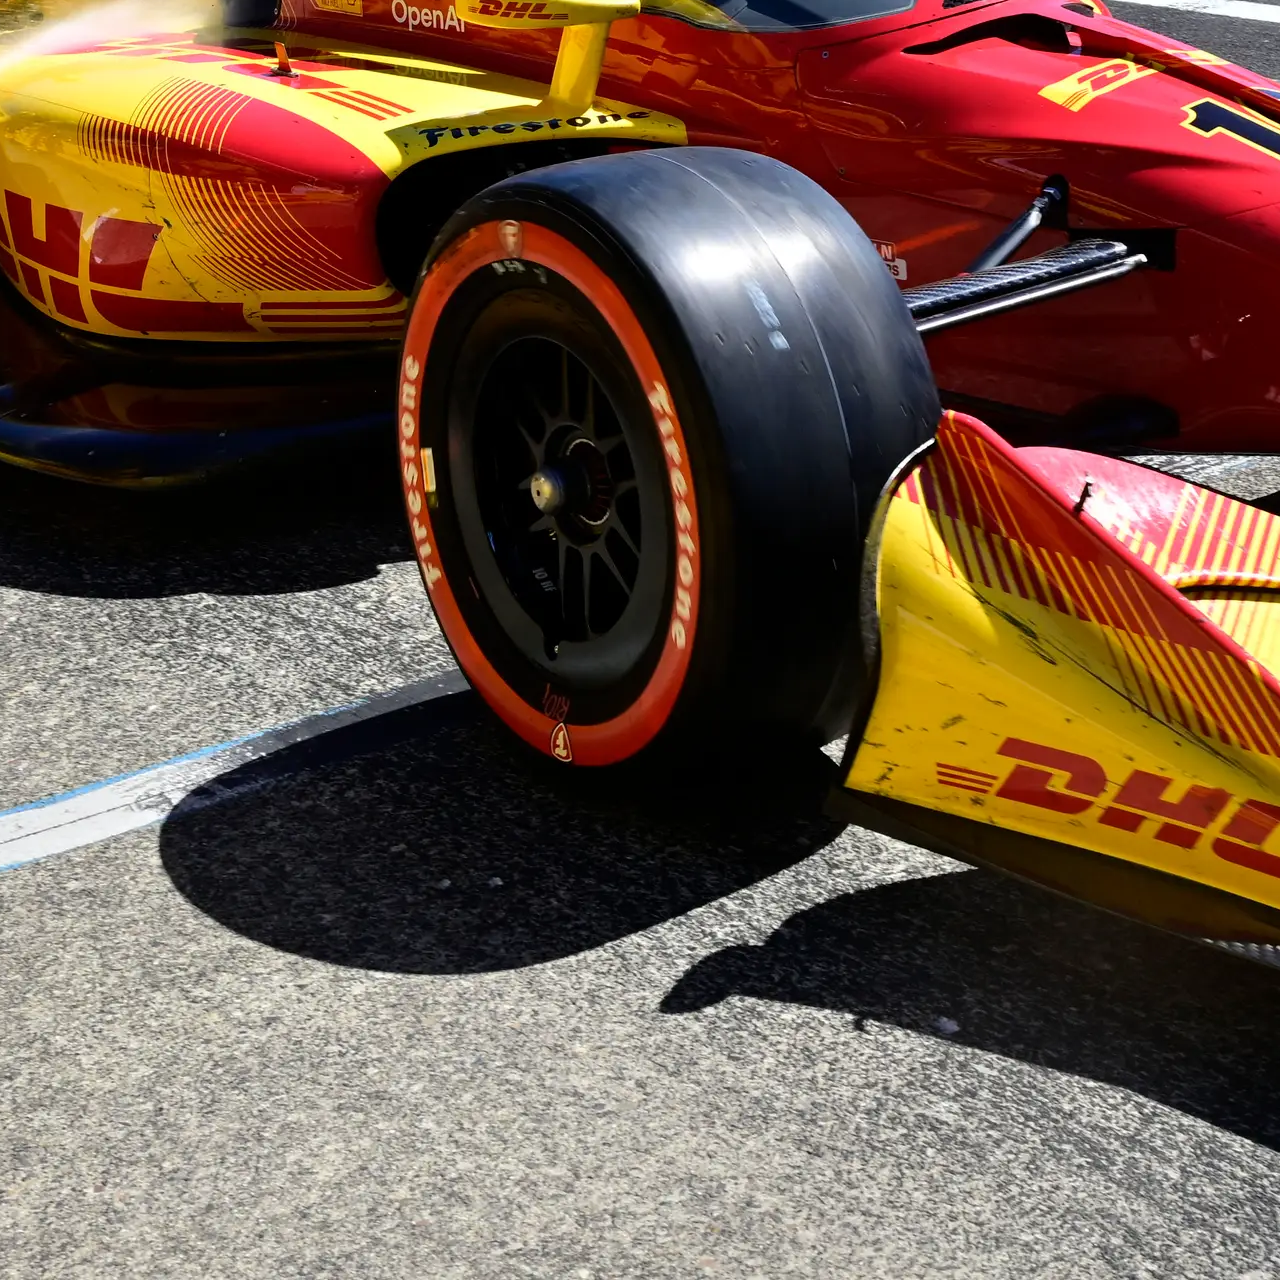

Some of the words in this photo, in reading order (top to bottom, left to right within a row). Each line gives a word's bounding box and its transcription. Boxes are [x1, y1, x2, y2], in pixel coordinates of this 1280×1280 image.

[419, 110, 651, 148] Firestone
[401, 354, 442, 592] Firestone
[647, 380, 698, 650] Firestone
